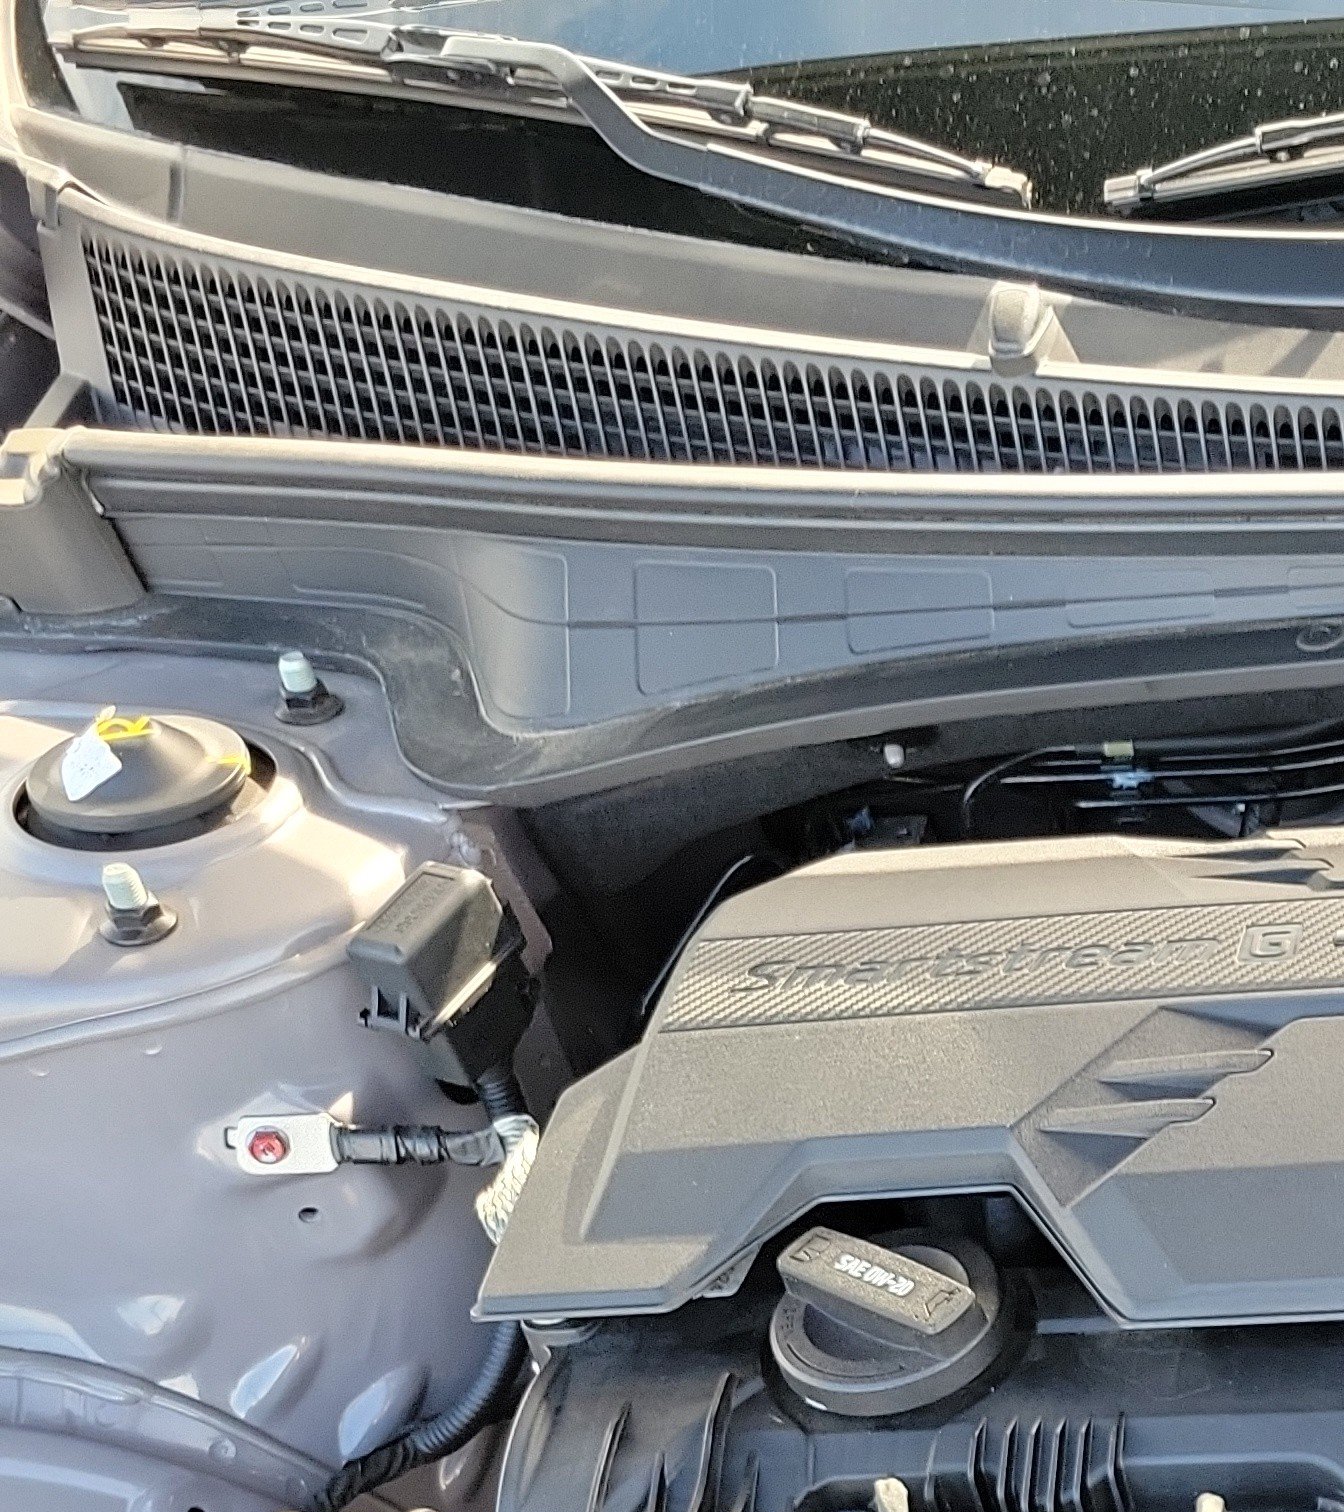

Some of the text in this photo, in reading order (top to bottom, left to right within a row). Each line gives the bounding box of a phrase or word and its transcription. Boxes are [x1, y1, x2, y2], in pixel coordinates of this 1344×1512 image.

[731, 937, 1221, 994] Smartstream
[834, 1253, 916, 1297] SAE 0W-20
